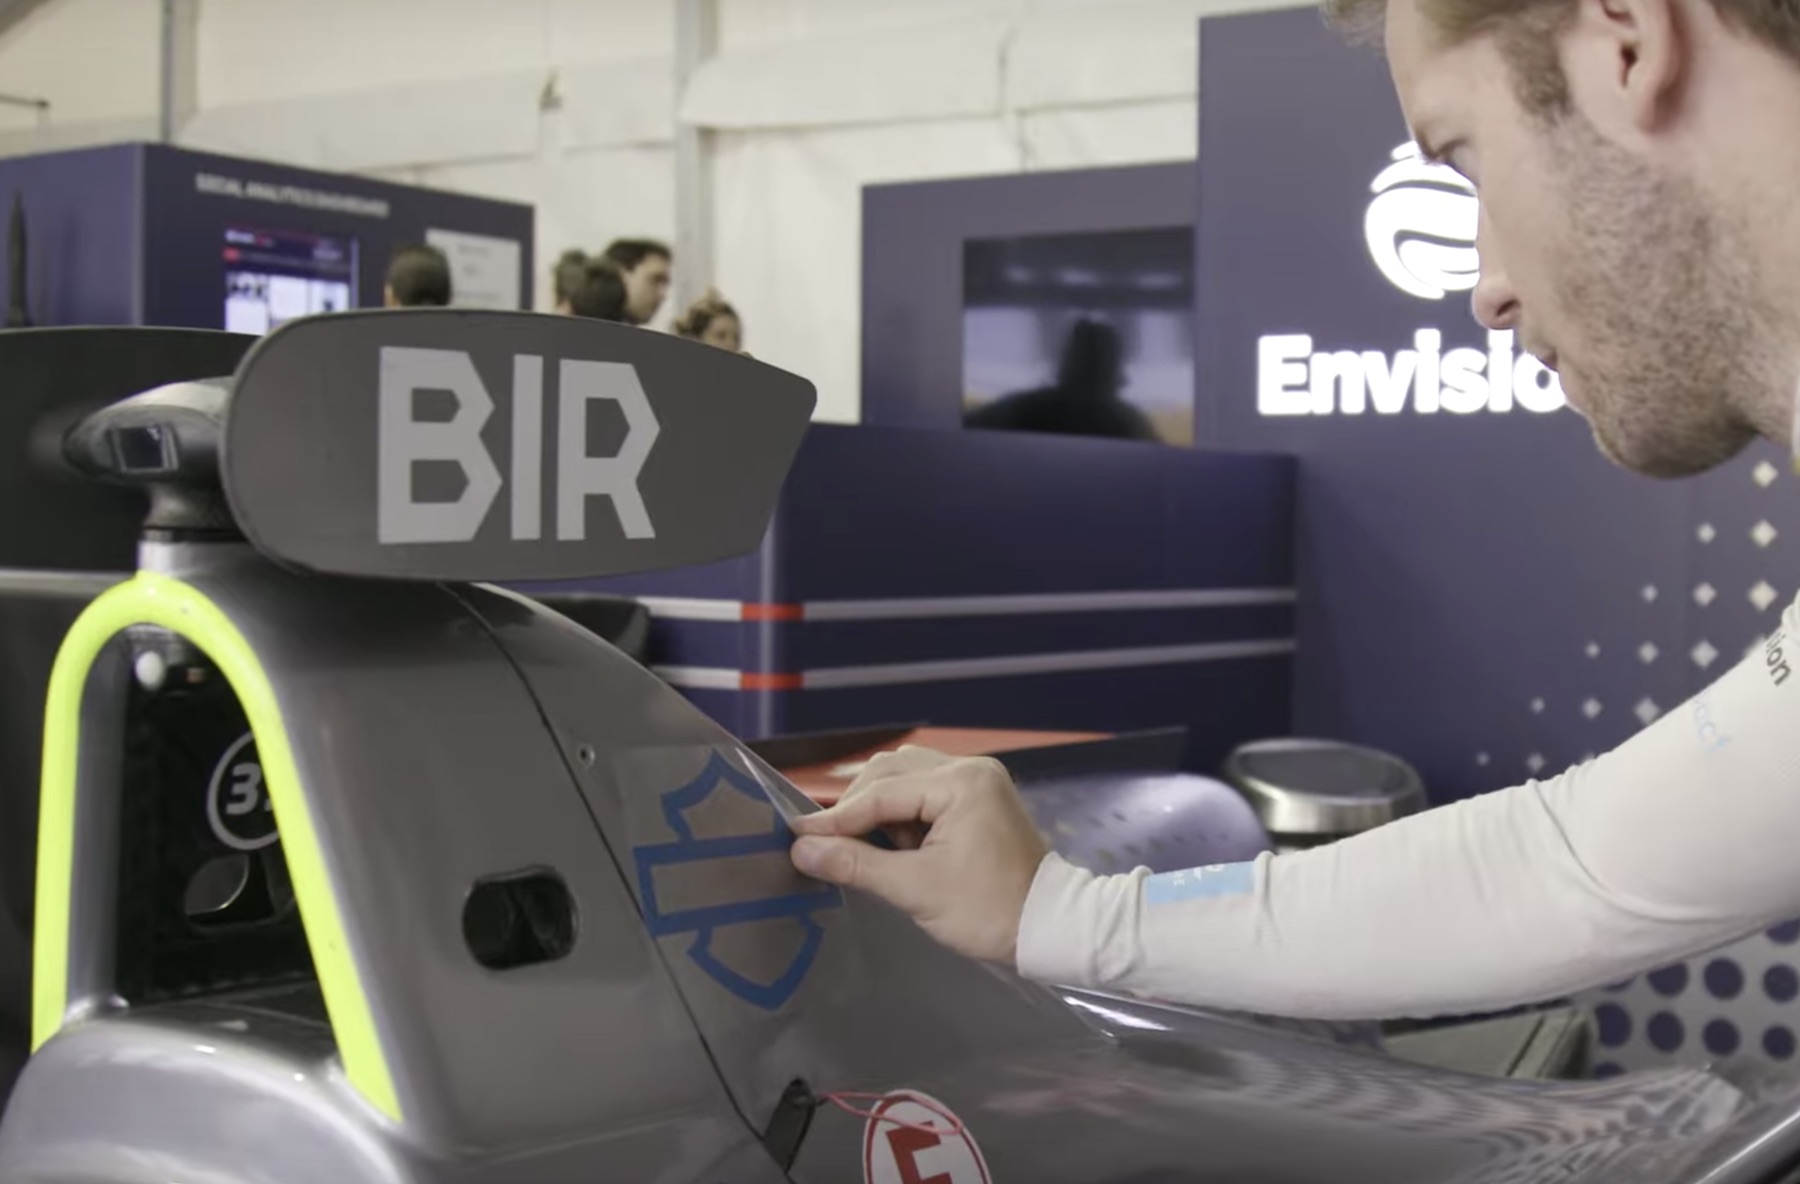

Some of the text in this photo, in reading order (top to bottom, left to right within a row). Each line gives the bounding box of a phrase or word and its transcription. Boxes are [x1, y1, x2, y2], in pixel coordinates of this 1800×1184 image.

[1257, 328, 1567, 416] Envisio
[378, 346, 661, 544] BIR
[1765, 630, 1792, 686] ion
[226, 762, 273, 815] 3
